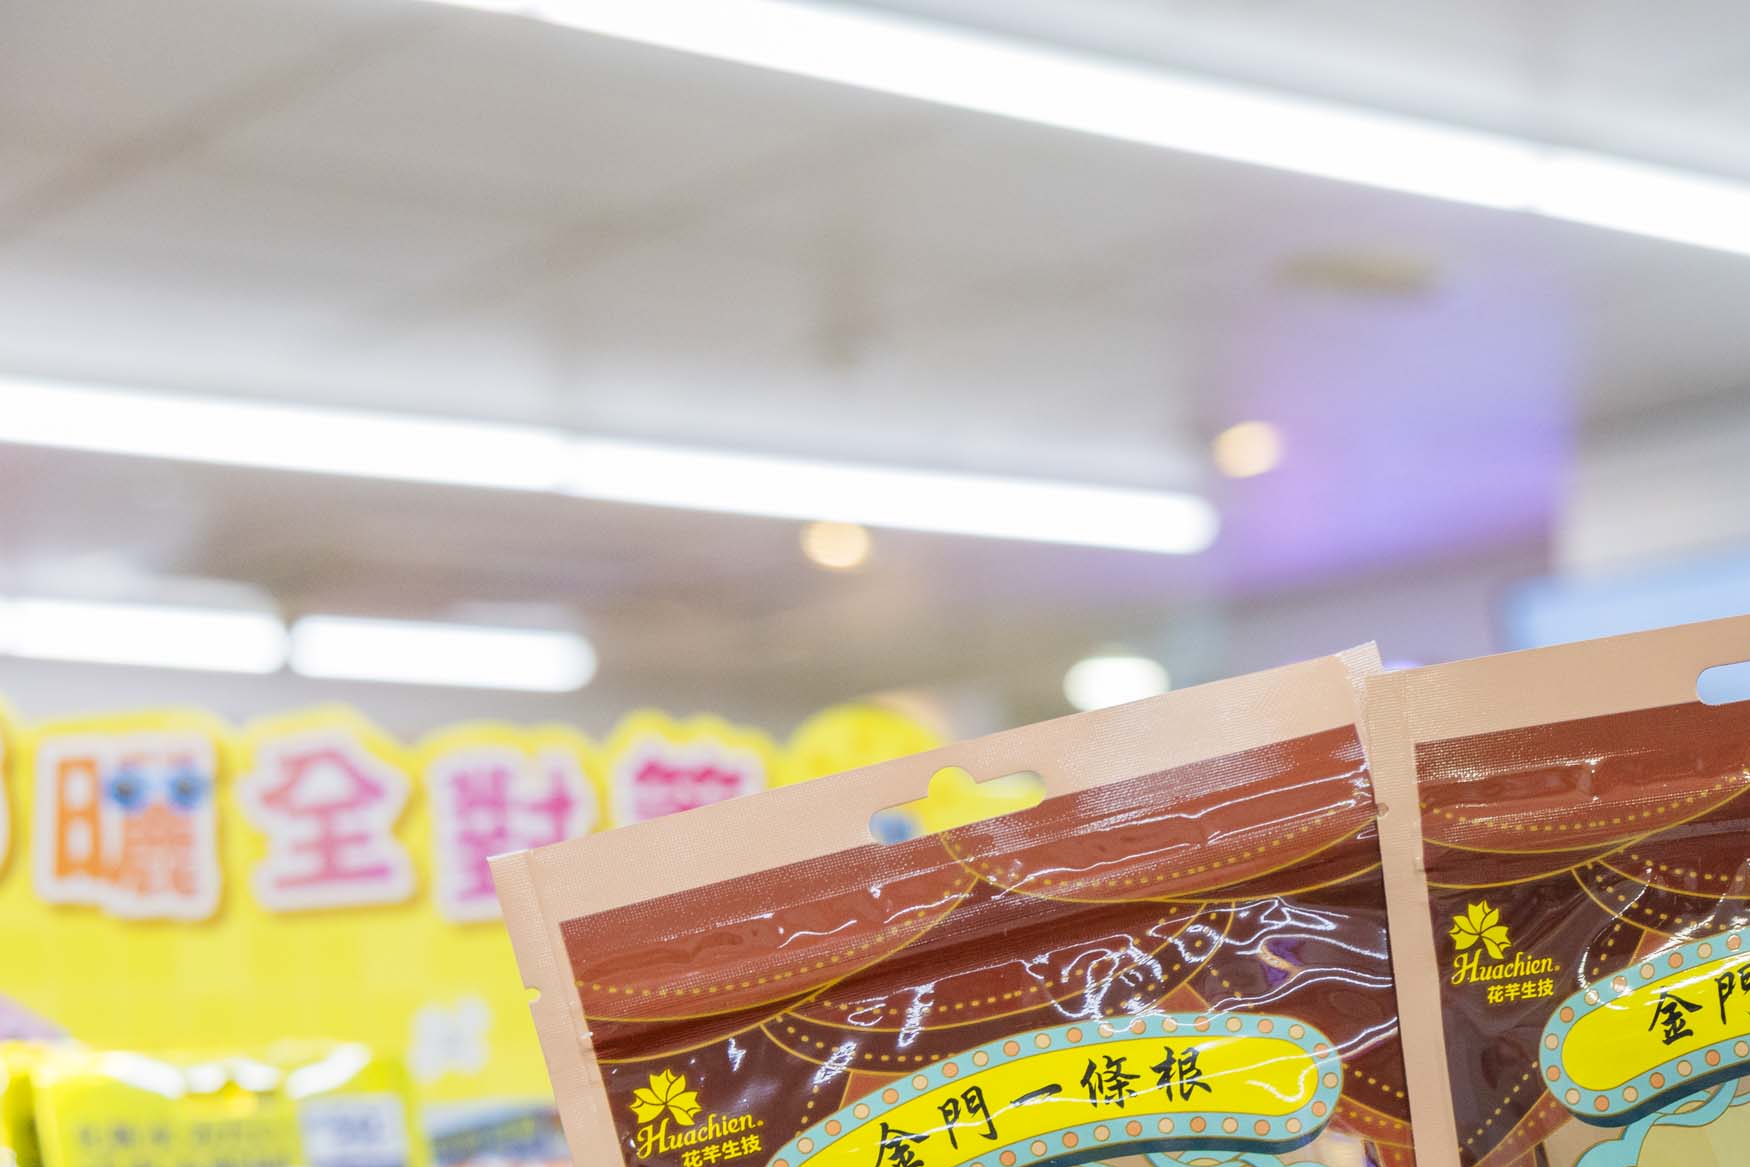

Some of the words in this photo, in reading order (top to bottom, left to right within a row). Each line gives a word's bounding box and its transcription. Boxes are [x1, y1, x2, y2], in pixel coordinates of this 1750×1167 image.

[1451, 948, 1553, 985] Huachien
[1487, 978, 1554, 1004] 花芊生技
[636, 1113, 756, 1160] Huachien
